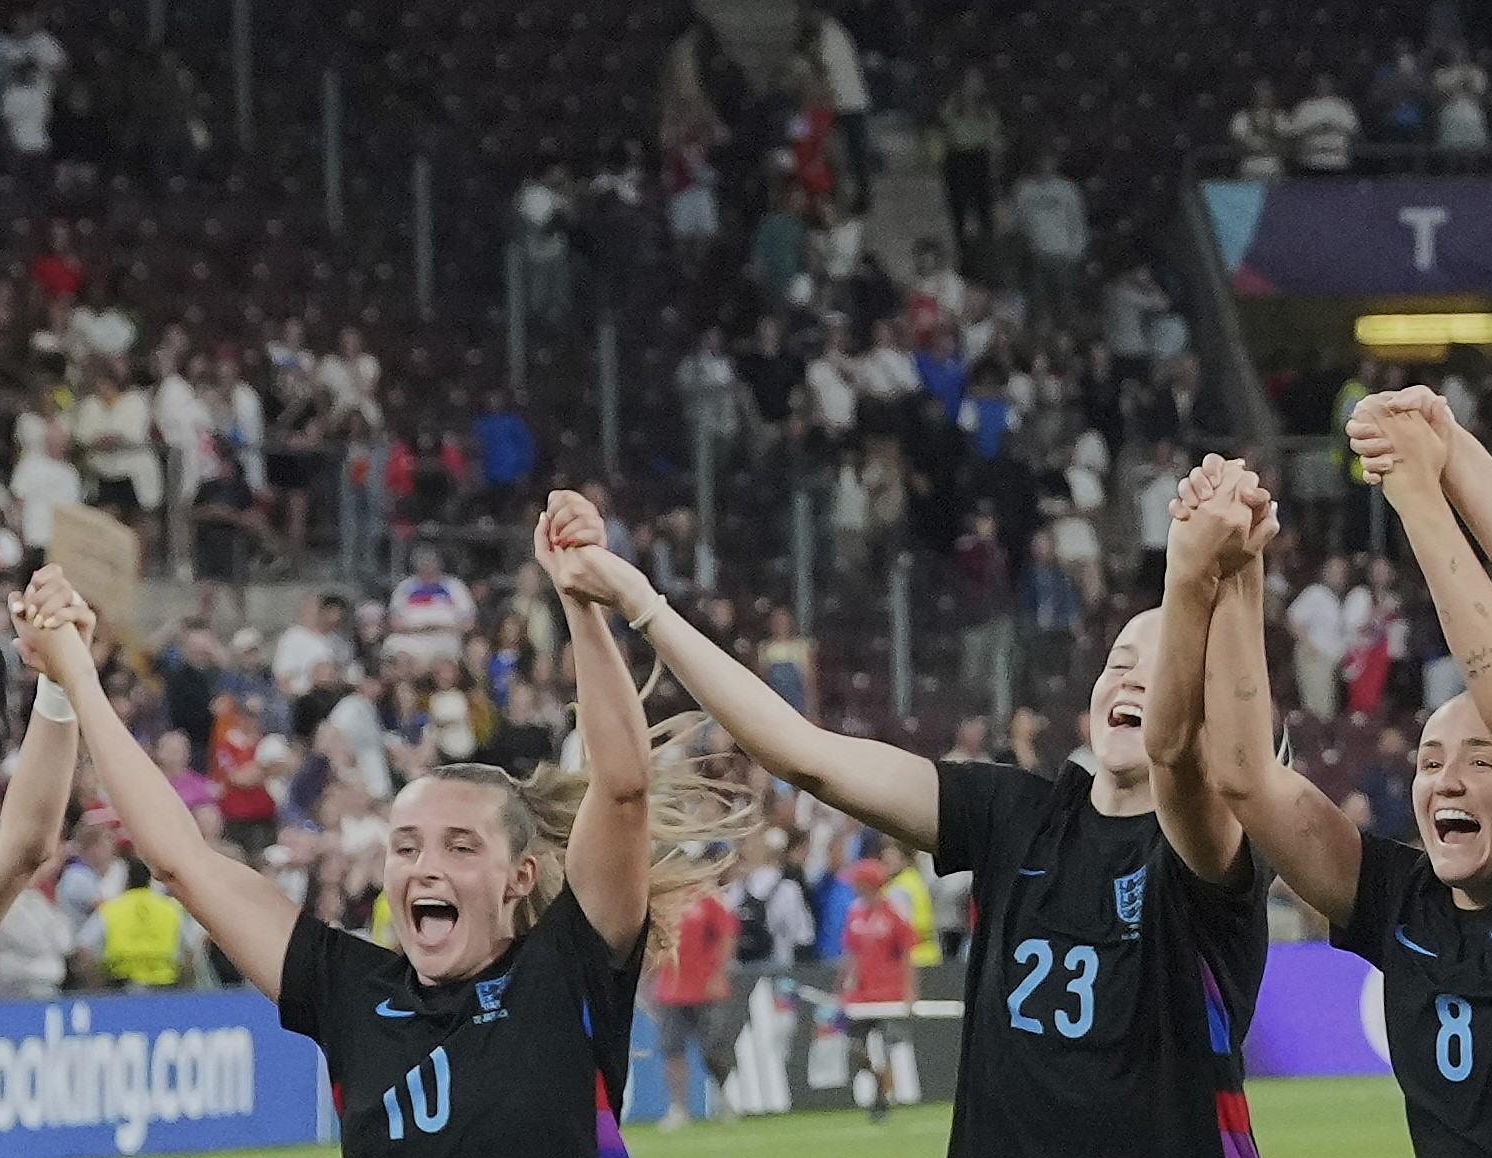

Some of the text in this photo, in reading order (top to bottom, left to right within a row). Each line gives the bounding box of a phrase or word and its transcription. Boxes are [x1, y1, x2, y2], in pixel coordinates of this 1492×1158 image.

[1399, 206, 1449, 272] T
[1006, 938, 1100, 1039] 23
[1435, 994, 1474, 1082] 8
[382, 1045, 451, 1140] 10
